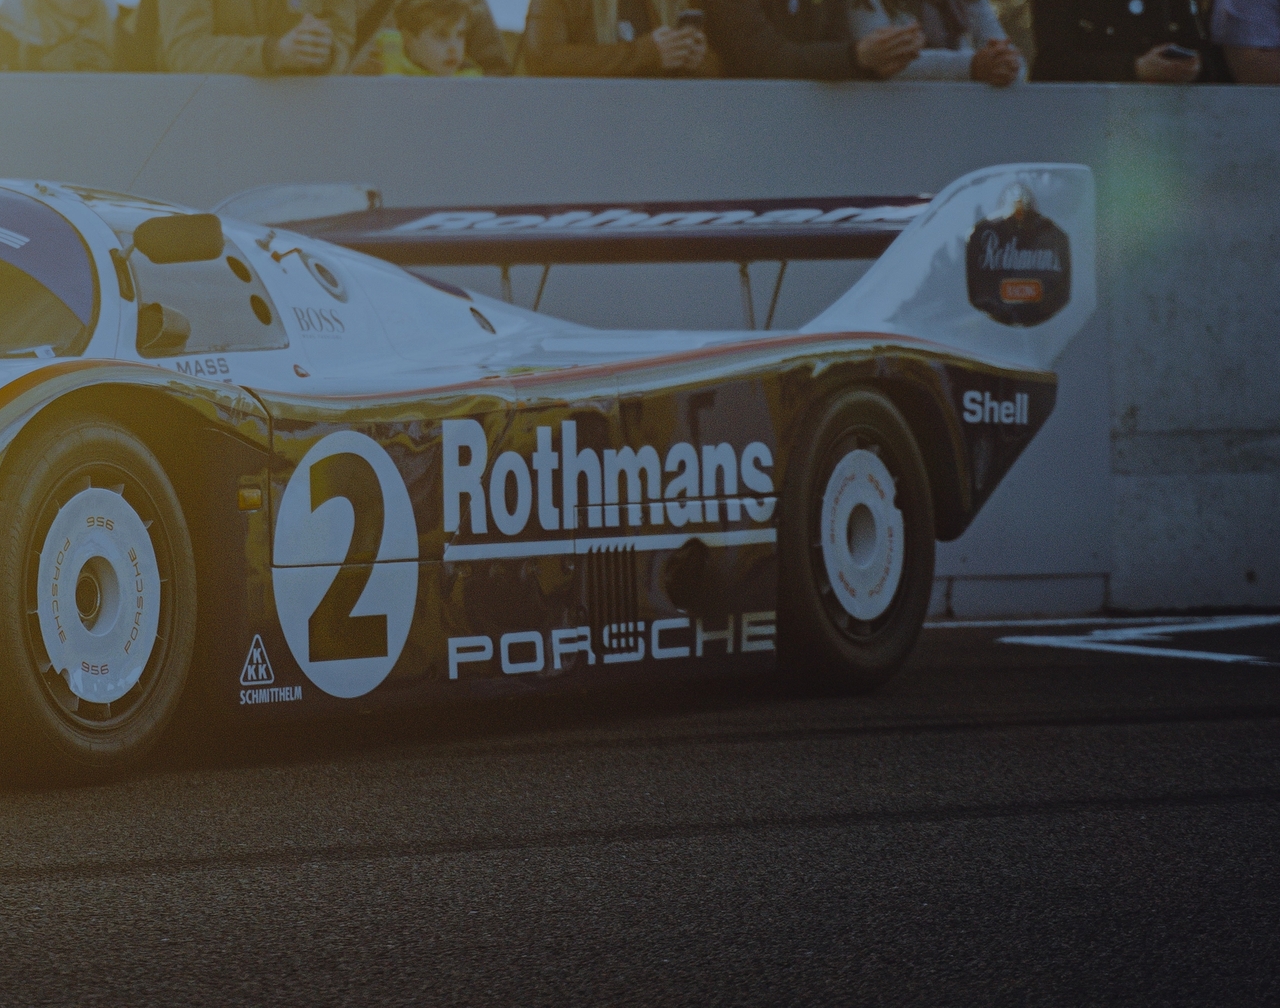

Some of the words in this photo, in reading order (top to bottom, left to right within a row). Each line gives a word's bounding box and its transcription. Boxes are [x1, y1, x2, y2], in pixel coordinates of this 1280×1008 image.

[291, 306, 345, 333] BOSS
[176, 357, 230, 377] MASS
[963, 390, 1029, 424] Shell
[442, 419, 778, 536] Rothmans
[86, 516, 114, 531] 956
[308, 451, 389, 662] 2
[51, 537, 71, 644] PORSCHE
[123, 547, 145, 654] PORSCHE
[447, 611, 777, 680] PORSCHE
[81, 661, 110, 676] 956
[239, 685, 303, 705] SCHMITTHELM
